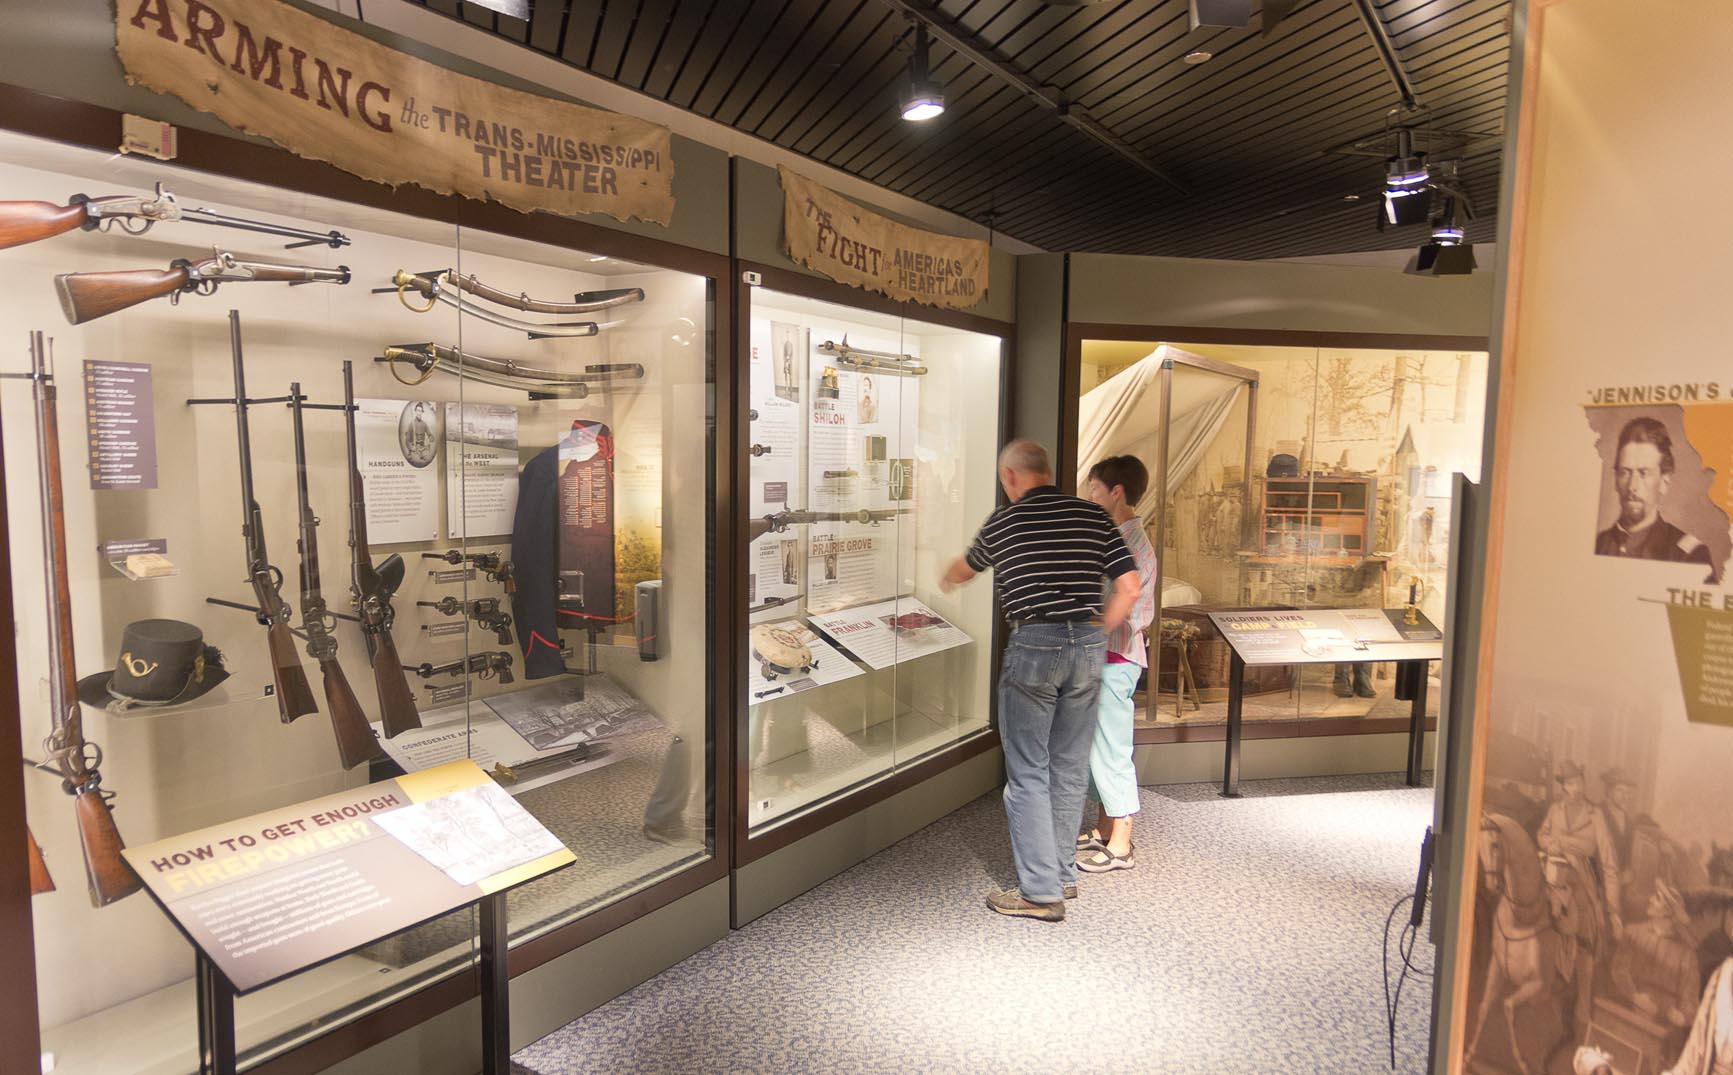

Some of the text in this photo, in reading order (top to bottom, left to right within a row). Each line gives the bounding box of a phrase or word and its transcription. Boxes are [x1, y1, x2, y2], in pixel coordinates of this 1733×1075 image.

[131, 0, 393, 133] ARMING
[400, 97, 430, 130] the
[474, 143, 619, 196] THEATER
[805, 197, 833, 226] THE
[815, 222, 882, 277] FIGHT
[898, 268, 976, 297] HEARTLAND
[814, 412, 846, 425] SHILOH
[812, 533, 834, 542] BATTLE
[812, 538, 873, 556] PRAIRIE GROVE
[1665, 587, 1713, 609] THE
[831, 620, 876, 636] FRANKLIN
[1230, 622, 1271, 631] CAMP
[1277, 621, 1318, 630] FIELD
[401, 733, 458, 751] CONFEDERATE
[150, 793, 400, 873] HOW TO GET ENOUGH
[164, 818, 372, 893] FIREPOWER?
